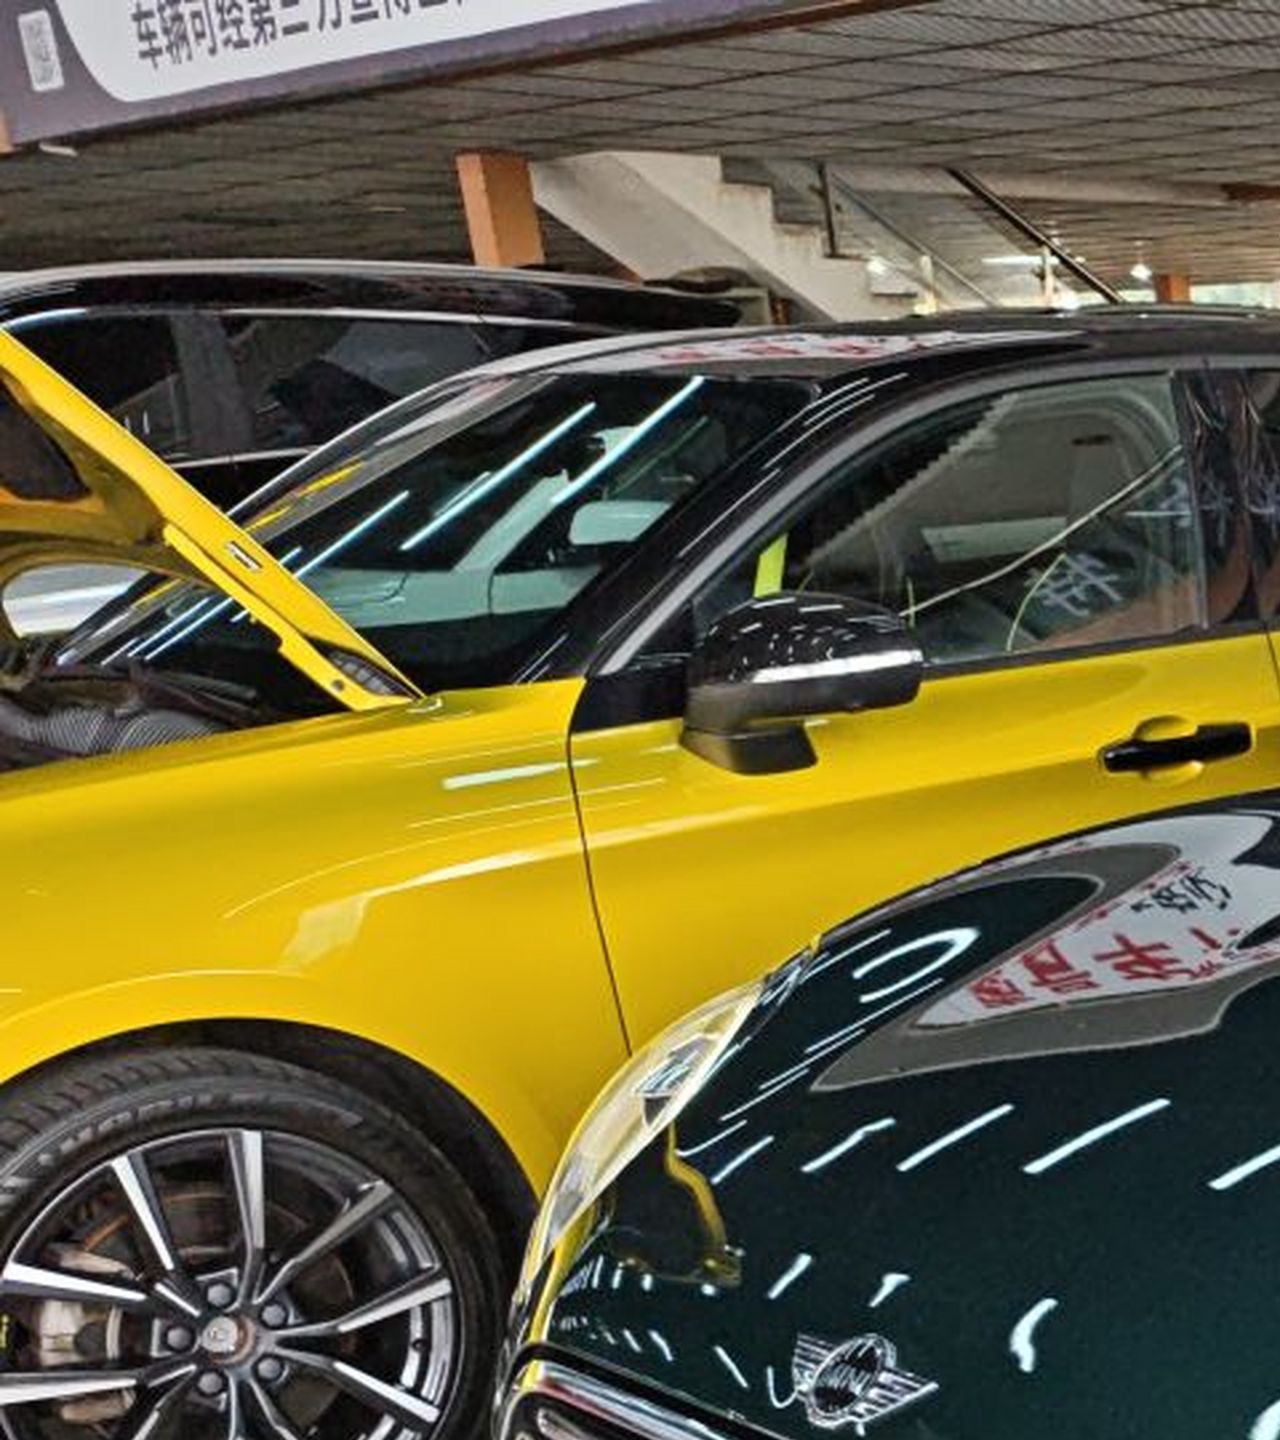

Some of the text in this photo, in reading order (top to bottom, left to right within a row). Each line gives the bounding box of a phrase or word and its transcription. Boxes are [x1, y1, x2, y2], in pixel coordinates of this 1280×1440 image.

[131, 0, 463, 69] 车辆可经第三方
